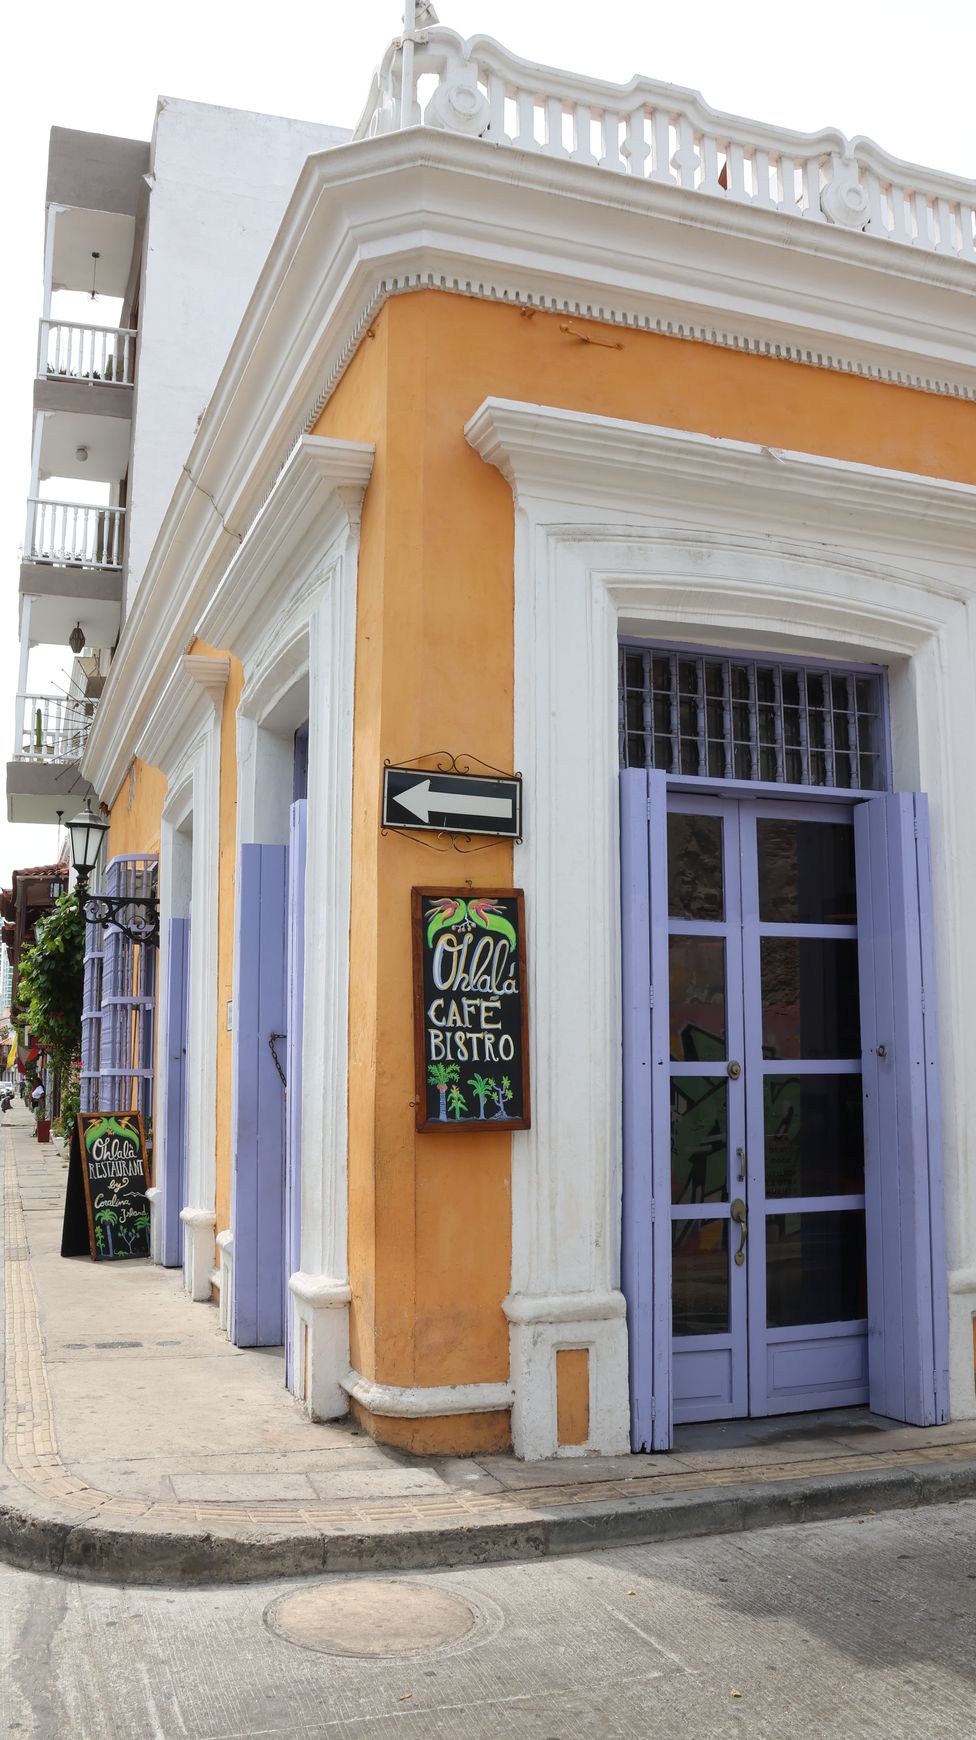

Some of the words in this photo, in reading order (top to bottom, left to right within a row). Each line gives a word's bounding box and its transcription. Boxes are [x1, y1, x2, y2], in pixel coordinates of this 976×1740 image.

[432, 932, 519, 996] Ohlalá
[427, 995, 502, 1030] CAFÉ
[428, 1029, 515, 1062] BISTRO
[88, 1160, 144, 1180] RESTAURANT
[107, 1177, 130, 1193] by
